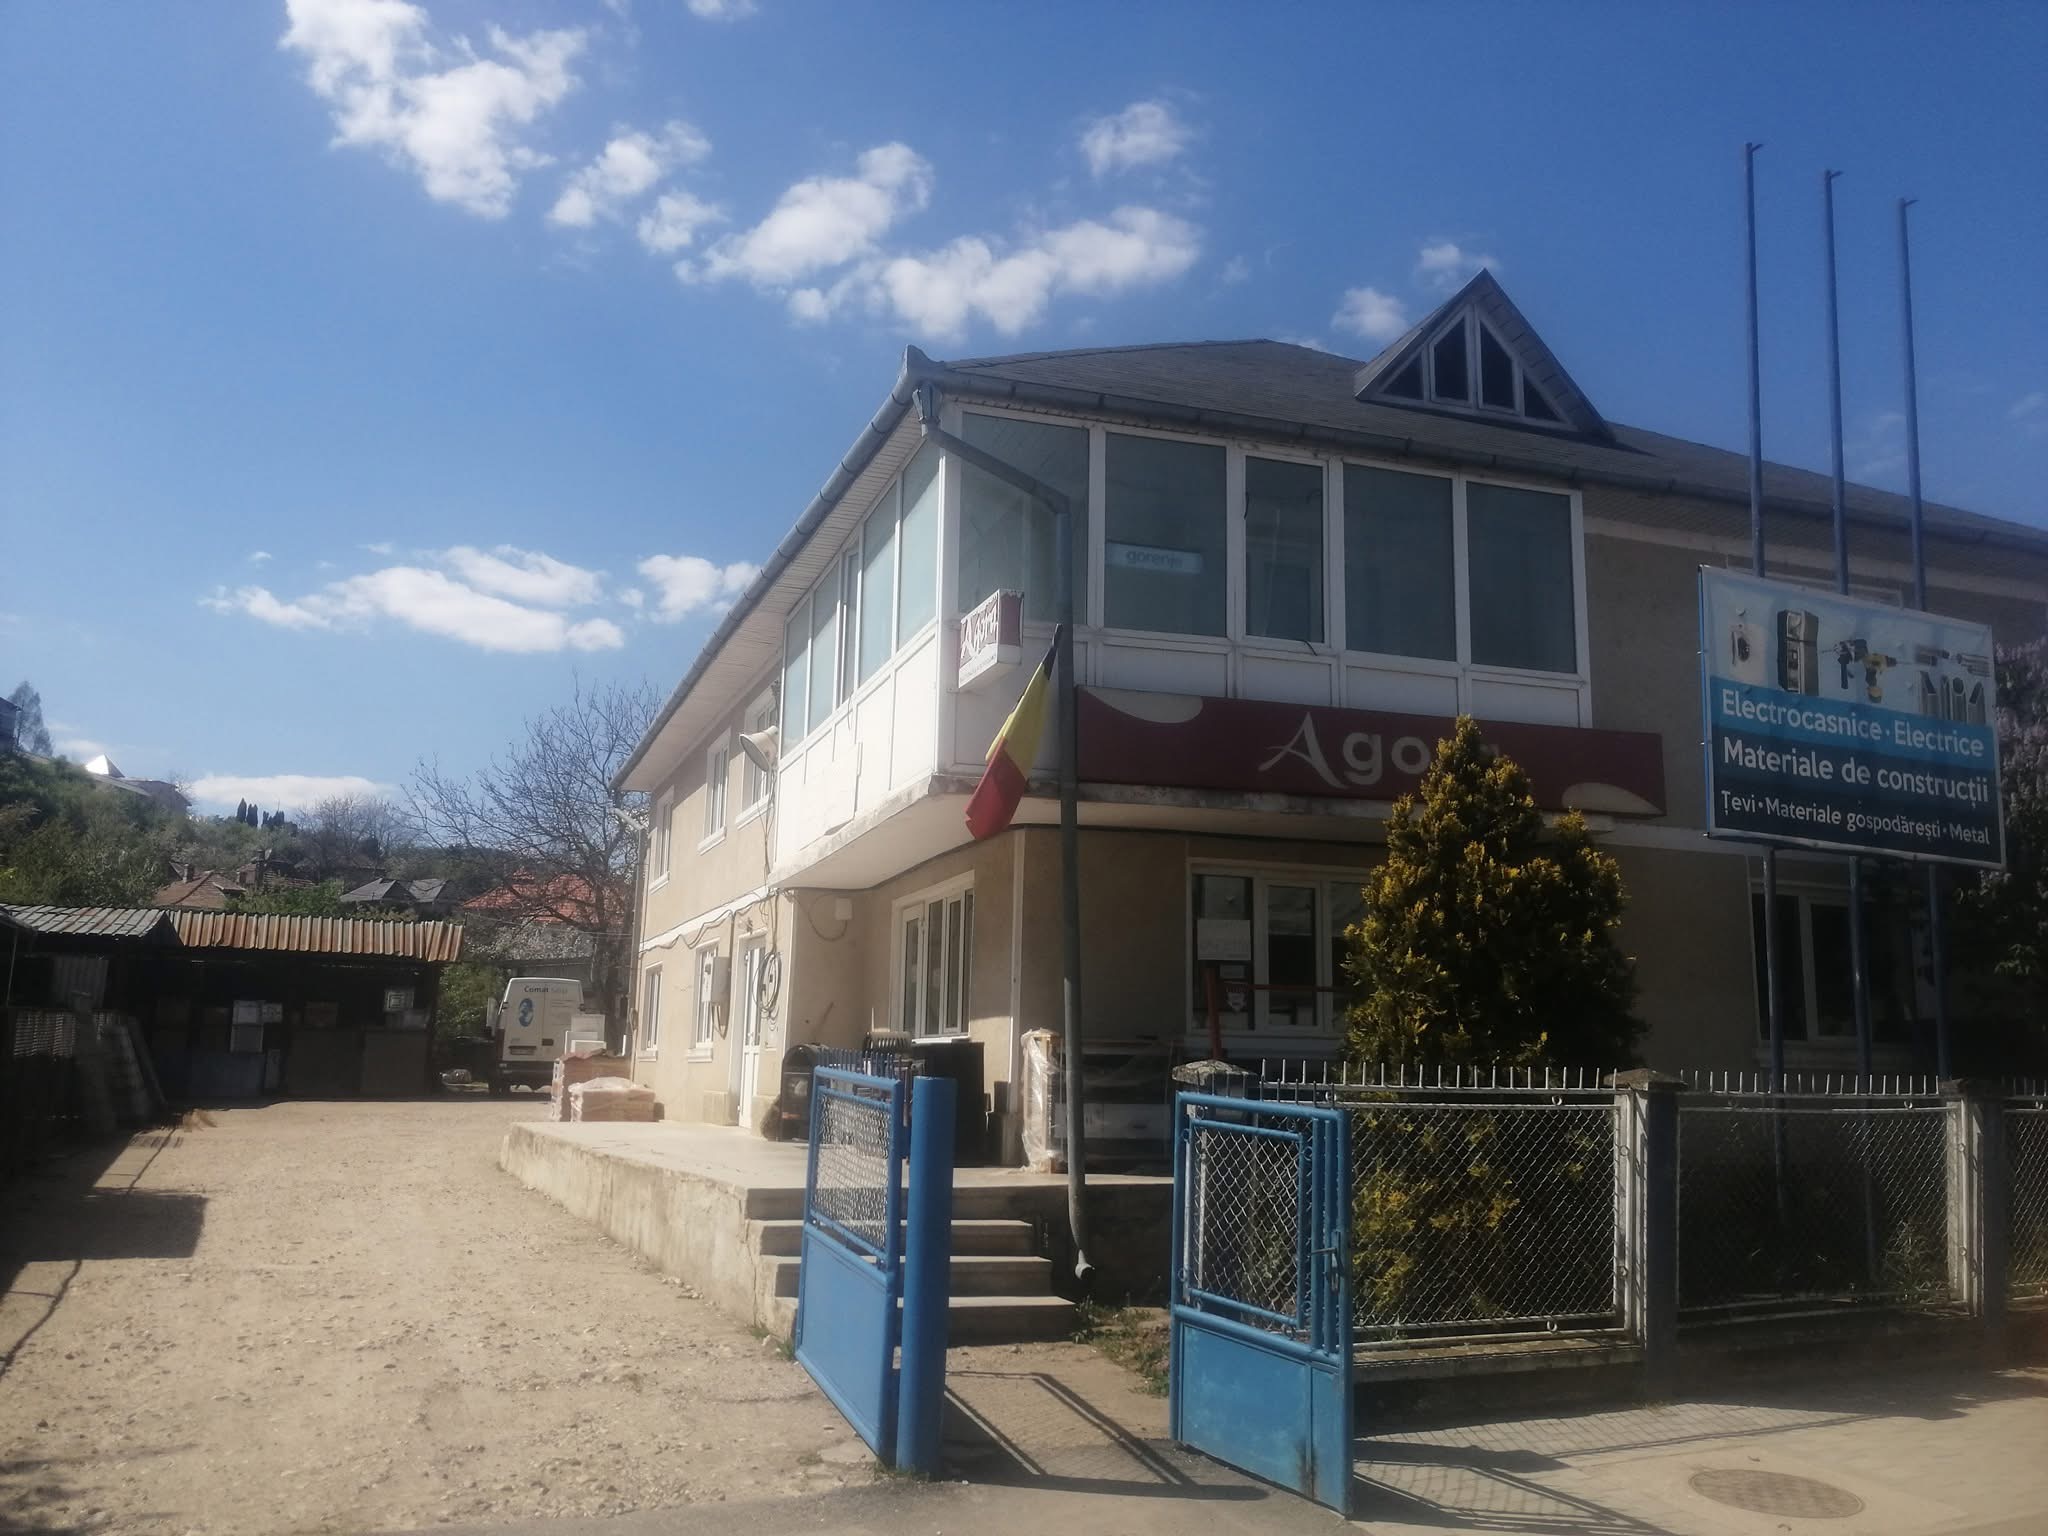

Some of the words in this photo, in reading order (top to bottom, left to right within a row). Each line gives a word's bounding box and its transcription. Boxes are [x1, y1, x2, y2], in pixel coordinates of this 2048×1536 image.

[1258, 711, 1500, 789] Ago
[1722, 688, 1882, 741] Electrocasnice
[1894, 720, 1984, 757] Electrice
[1723, 736, 1834, 780] Materiale
[1841, 757, 1871, 785] de
[1877, 767, 1989, 808] construcții
[1721, 790, 1756, 816] Țevi
[1765, 796, 1842, 825] Materiale
[1847, 811, 1941, 842] gospodărești
[1950, 823, 1991, 846] Metal
